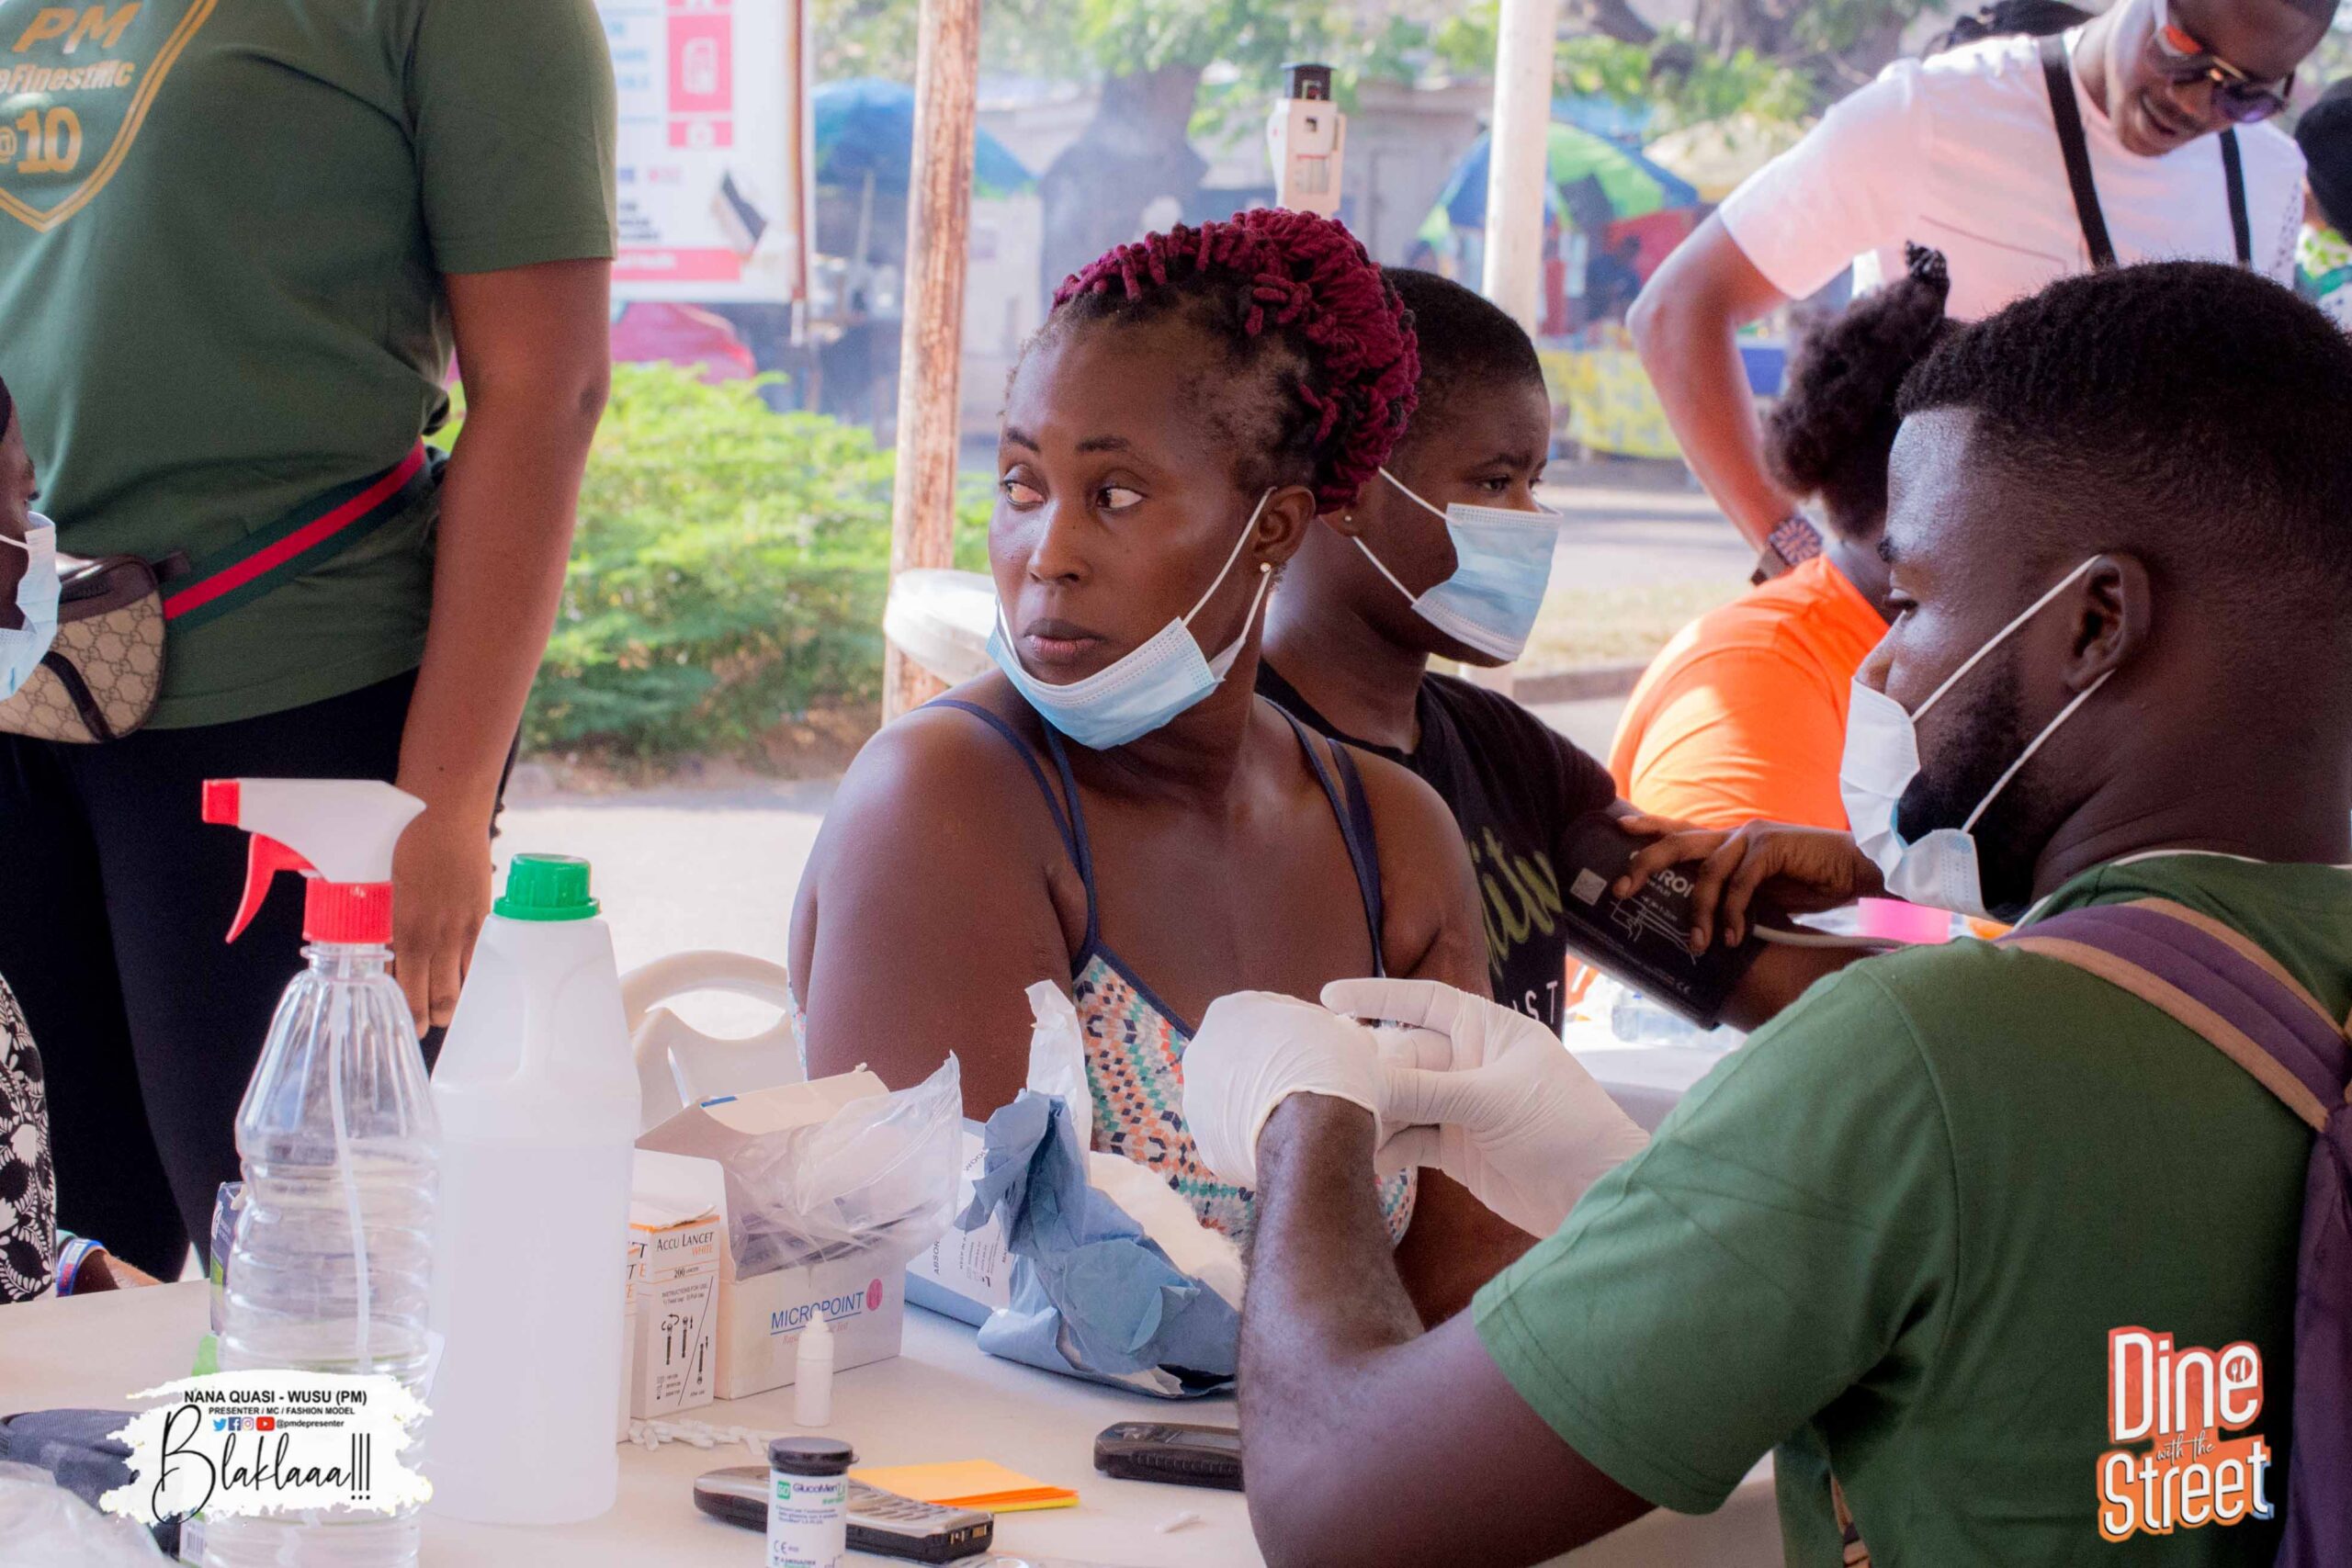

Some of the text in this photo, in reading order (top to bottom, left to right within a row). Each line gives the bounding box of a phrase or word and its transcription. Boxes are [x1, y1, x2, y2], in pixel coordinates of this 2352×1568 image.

[11, 3, 141, 55] PM
[657, 1237, 680, 1251] ACCU
[682, 1232, 714, 1247] LANCET
[933, 1240, 941, 1276] ABSOR
[673, 1267, 685, 1279] 200
[772, 1291, 865, 1330] MICROPOINT
